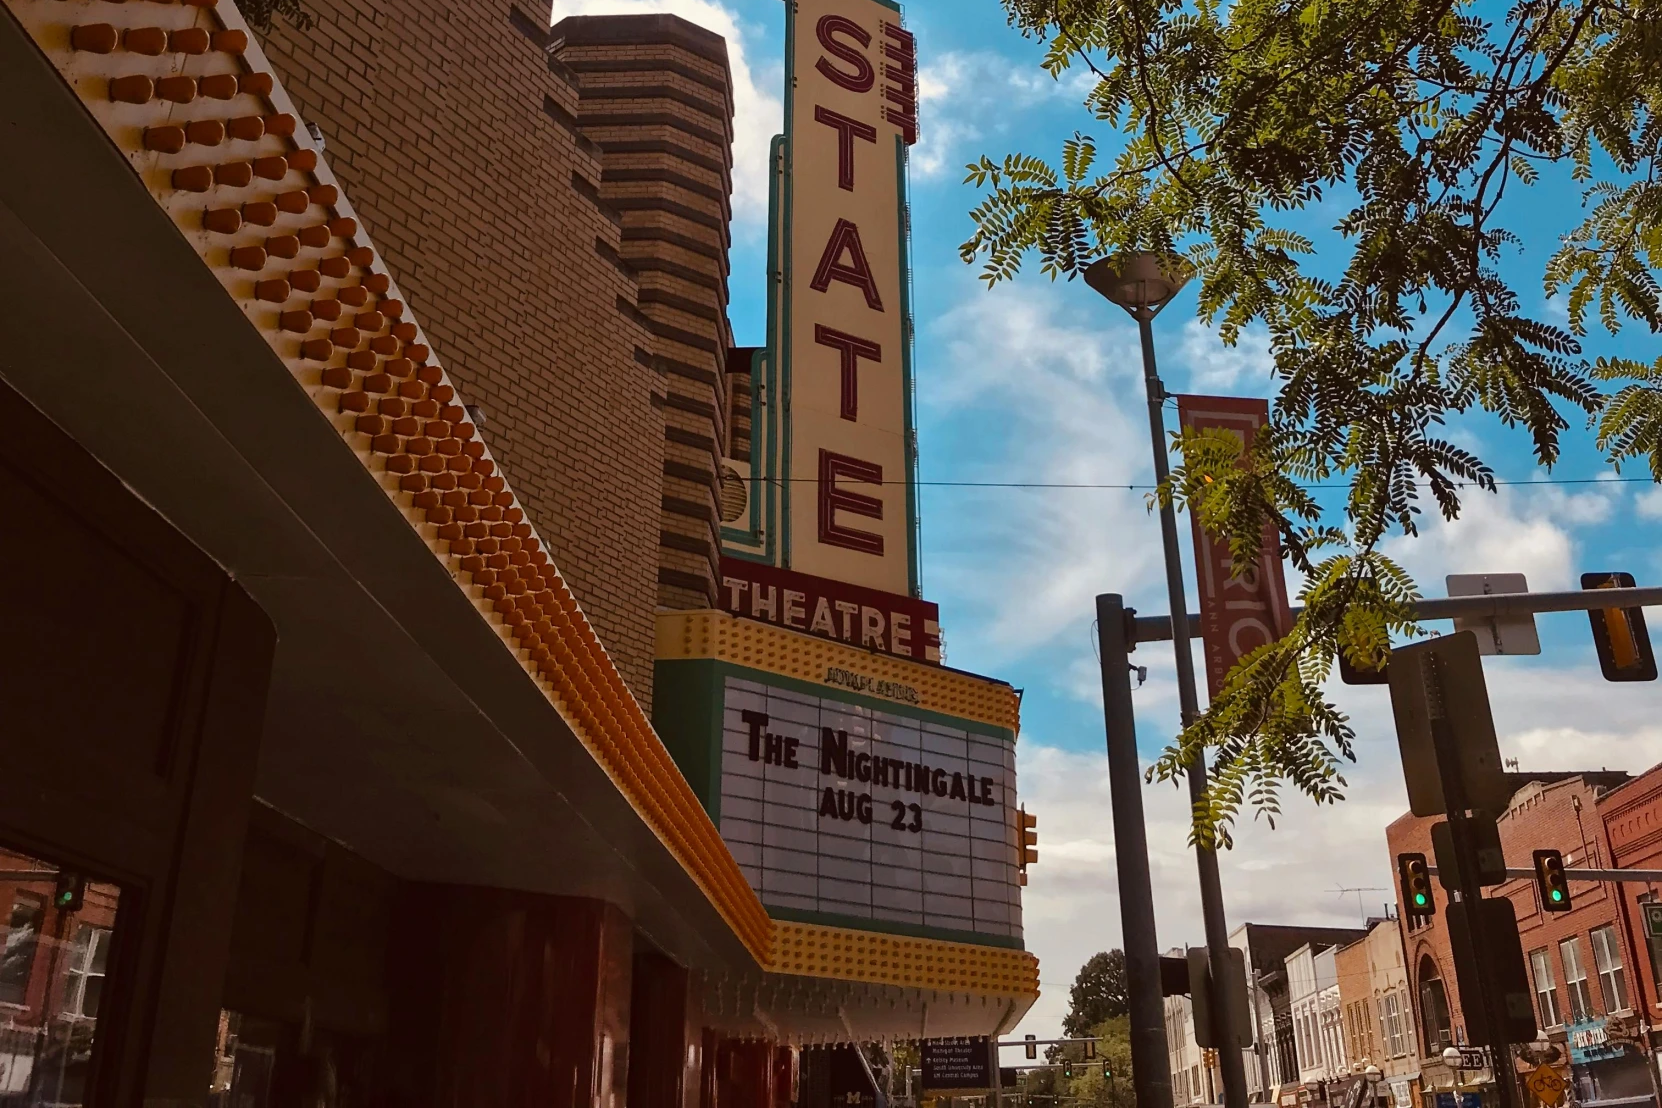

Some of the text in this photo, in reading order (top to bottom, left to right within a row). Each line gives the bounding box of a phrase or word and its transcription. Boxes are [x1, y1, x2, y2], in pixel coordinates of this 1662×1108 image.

[809, 13, 885, 557] STATE
[723, 576, 912, 656] THEATRE
[1207, 600, 1225, 688] ANN ARBO
[819, 787, 923, 834] AUG 23
